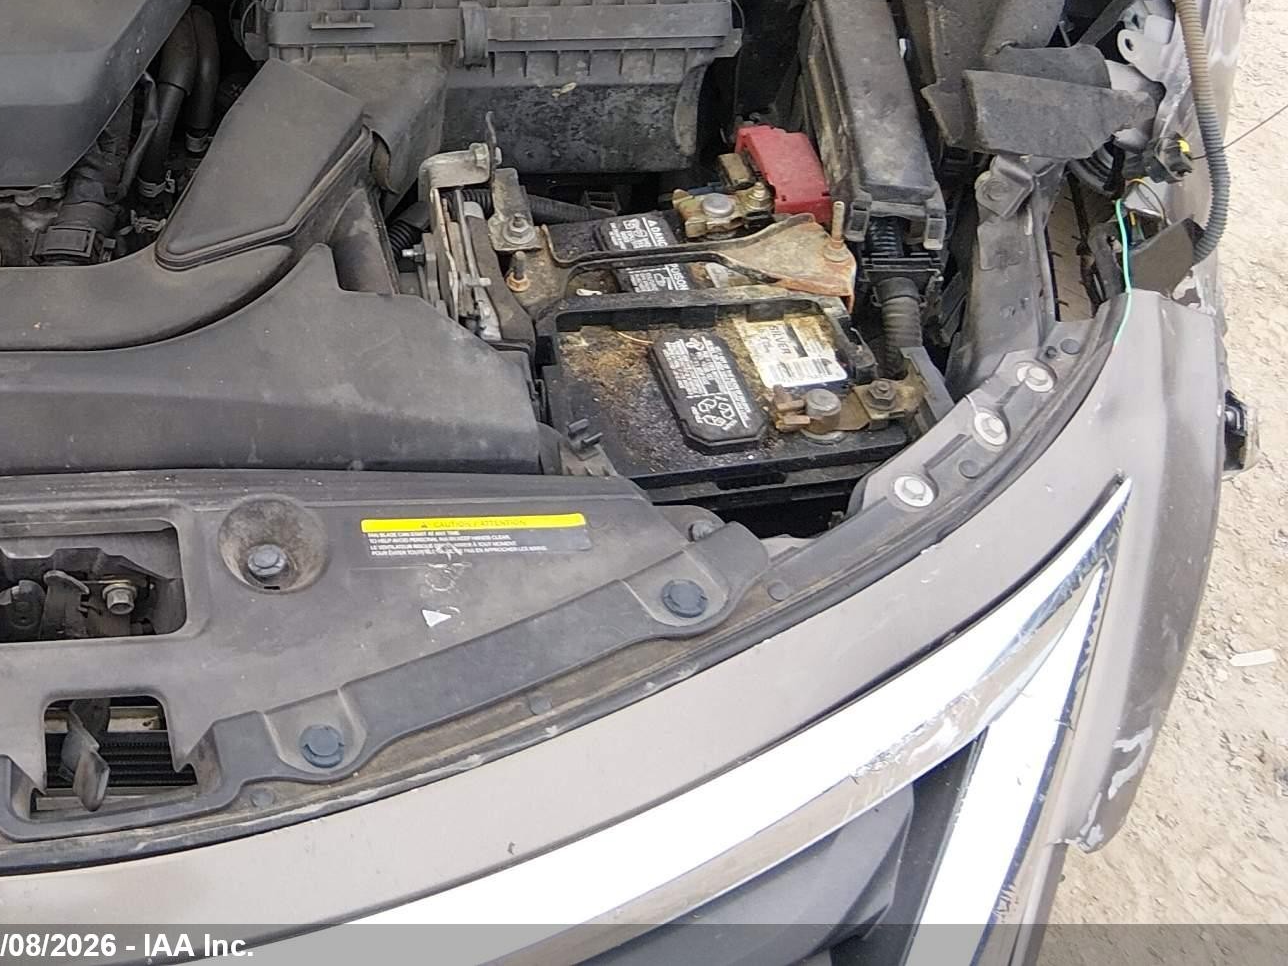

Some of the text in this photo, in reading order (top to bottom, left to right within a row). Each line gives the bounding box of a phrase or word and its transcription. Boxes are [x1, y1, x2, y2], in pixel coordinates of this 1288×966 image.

[650, 226, 668, 247] DANG
[666, 263, 690, 291] POISON
[769, 324, 792, 355] SILVER
